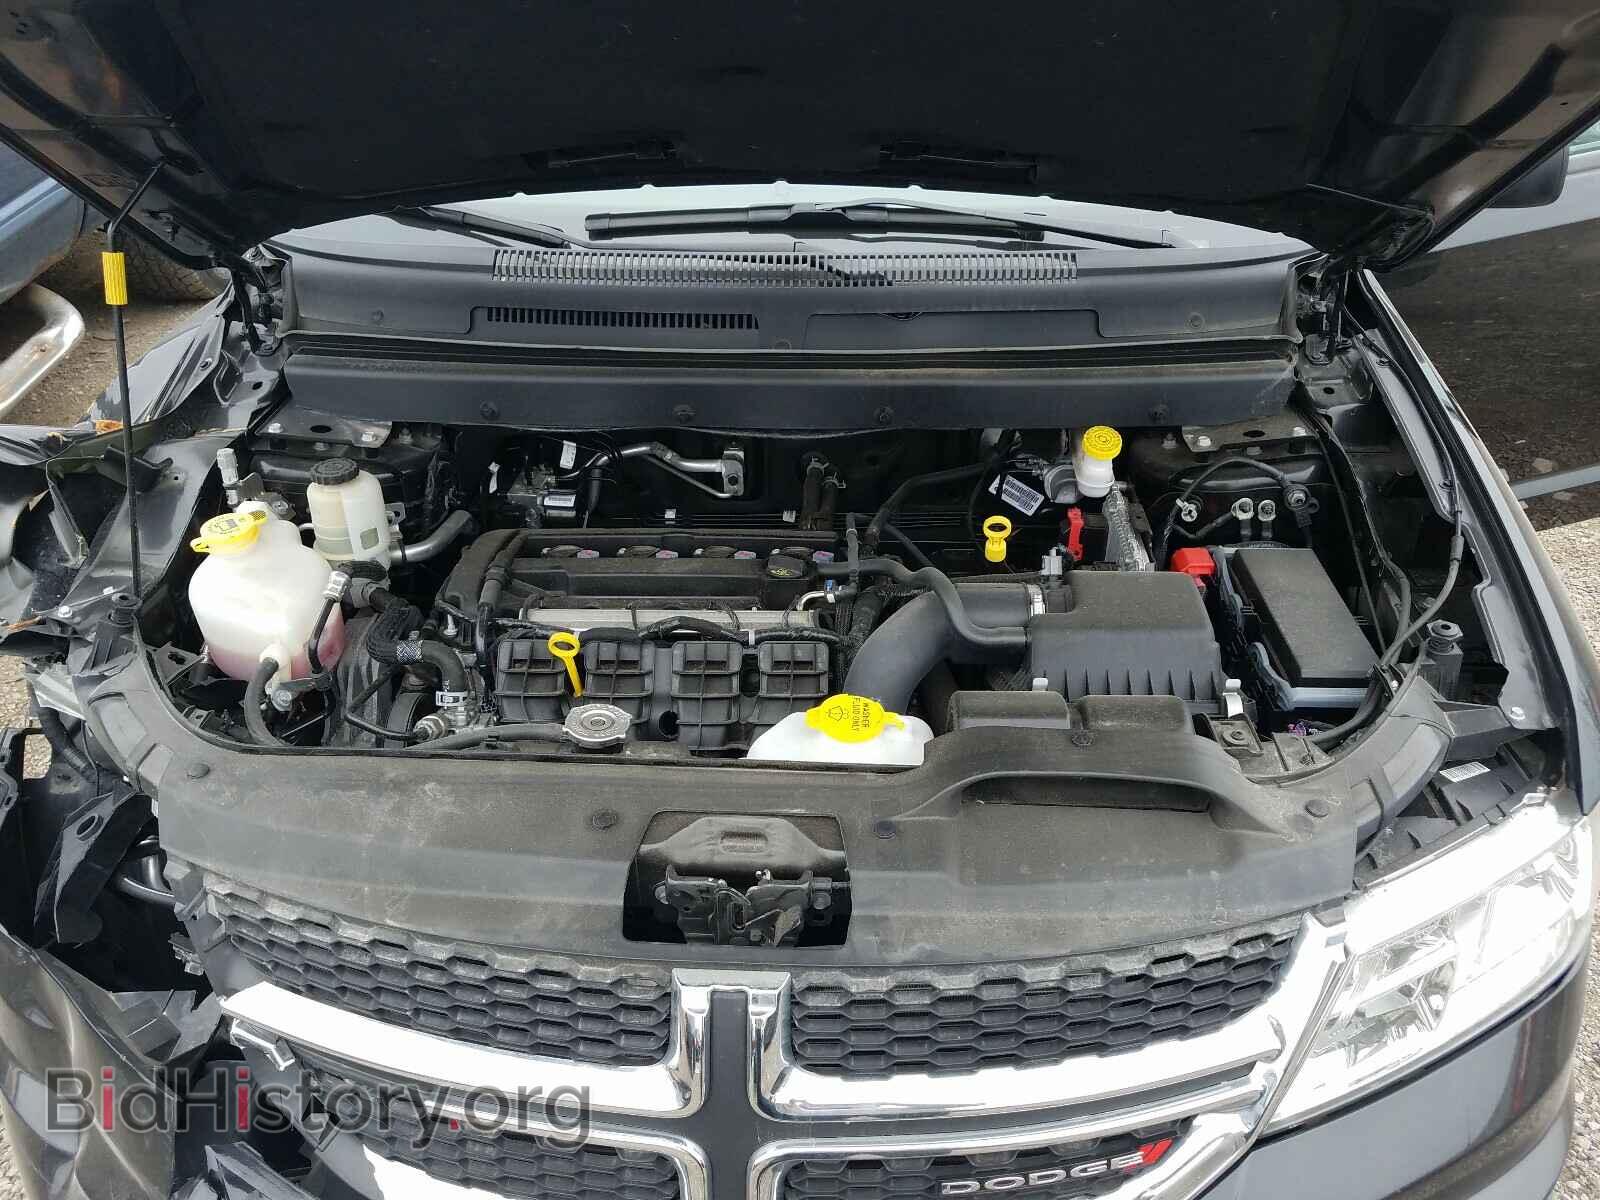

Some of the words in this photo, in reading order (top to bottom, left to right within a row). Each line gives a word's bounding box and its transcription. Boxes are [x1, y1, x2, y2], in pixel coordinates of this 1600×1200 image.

[852, 697, 861, 715] FLUID
[862, 701, 870, 728] WASHER
[852, 715, 861, 732] ONLY
[941, 1151, 1144, 1195] DODGE
